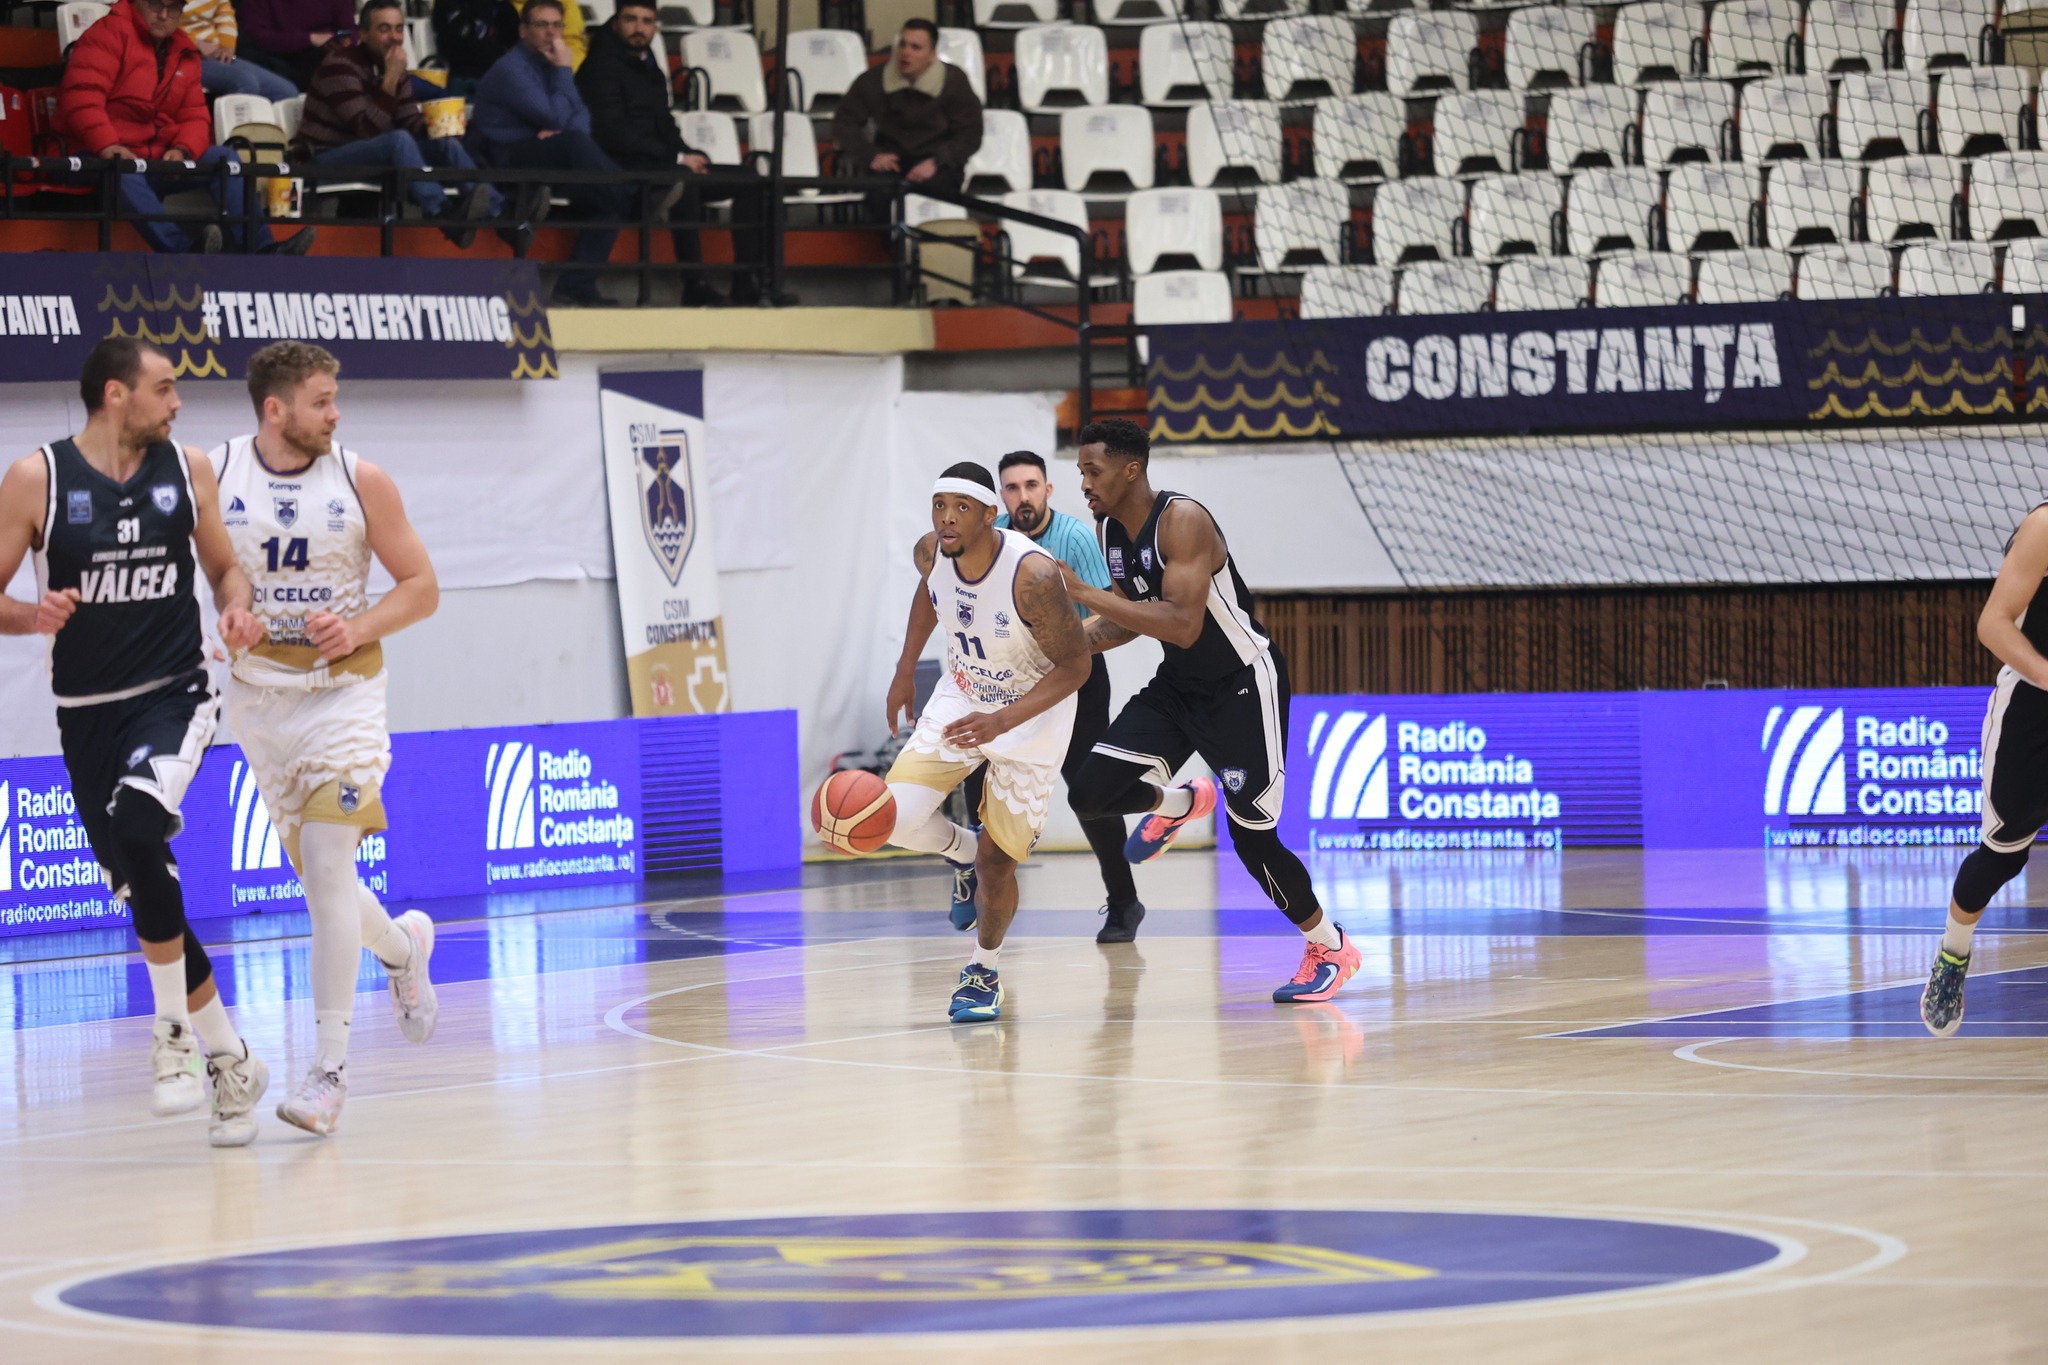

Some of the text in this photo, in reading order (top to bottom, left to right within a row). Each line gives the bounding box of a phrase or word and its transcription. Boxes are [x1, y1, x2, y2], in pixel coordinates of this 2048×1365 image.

[202, 291, 513, 342] #TEAMISEVERYTHING
[1366, 322, 1782, 403] CONSTANȚA
[117, 517, 140, 544] 31
[260, 537, 309, 573] 14
[80, 562, 178, 604] VÂLCEA
[955, 586, 977, 600] Kempa
[663, 599, 690, 621] CSM
[954, 631, 986, 660] 11
[1398, 720, 1486, 752] Radio
[1856, 715, 1949, 747] Radio
[539, 748, 592, 780] Radio
[1399, 753, 1533, 784] România
[1857, 748, 1983, 779] Români
[17, 785, 76, 818] Radio
[539, 779, 619, 813] România
[1400, 787, 1561, 825] Constanța
[18, 819, 92, 853] Român
[540, 813, 634, 849] Constanța
